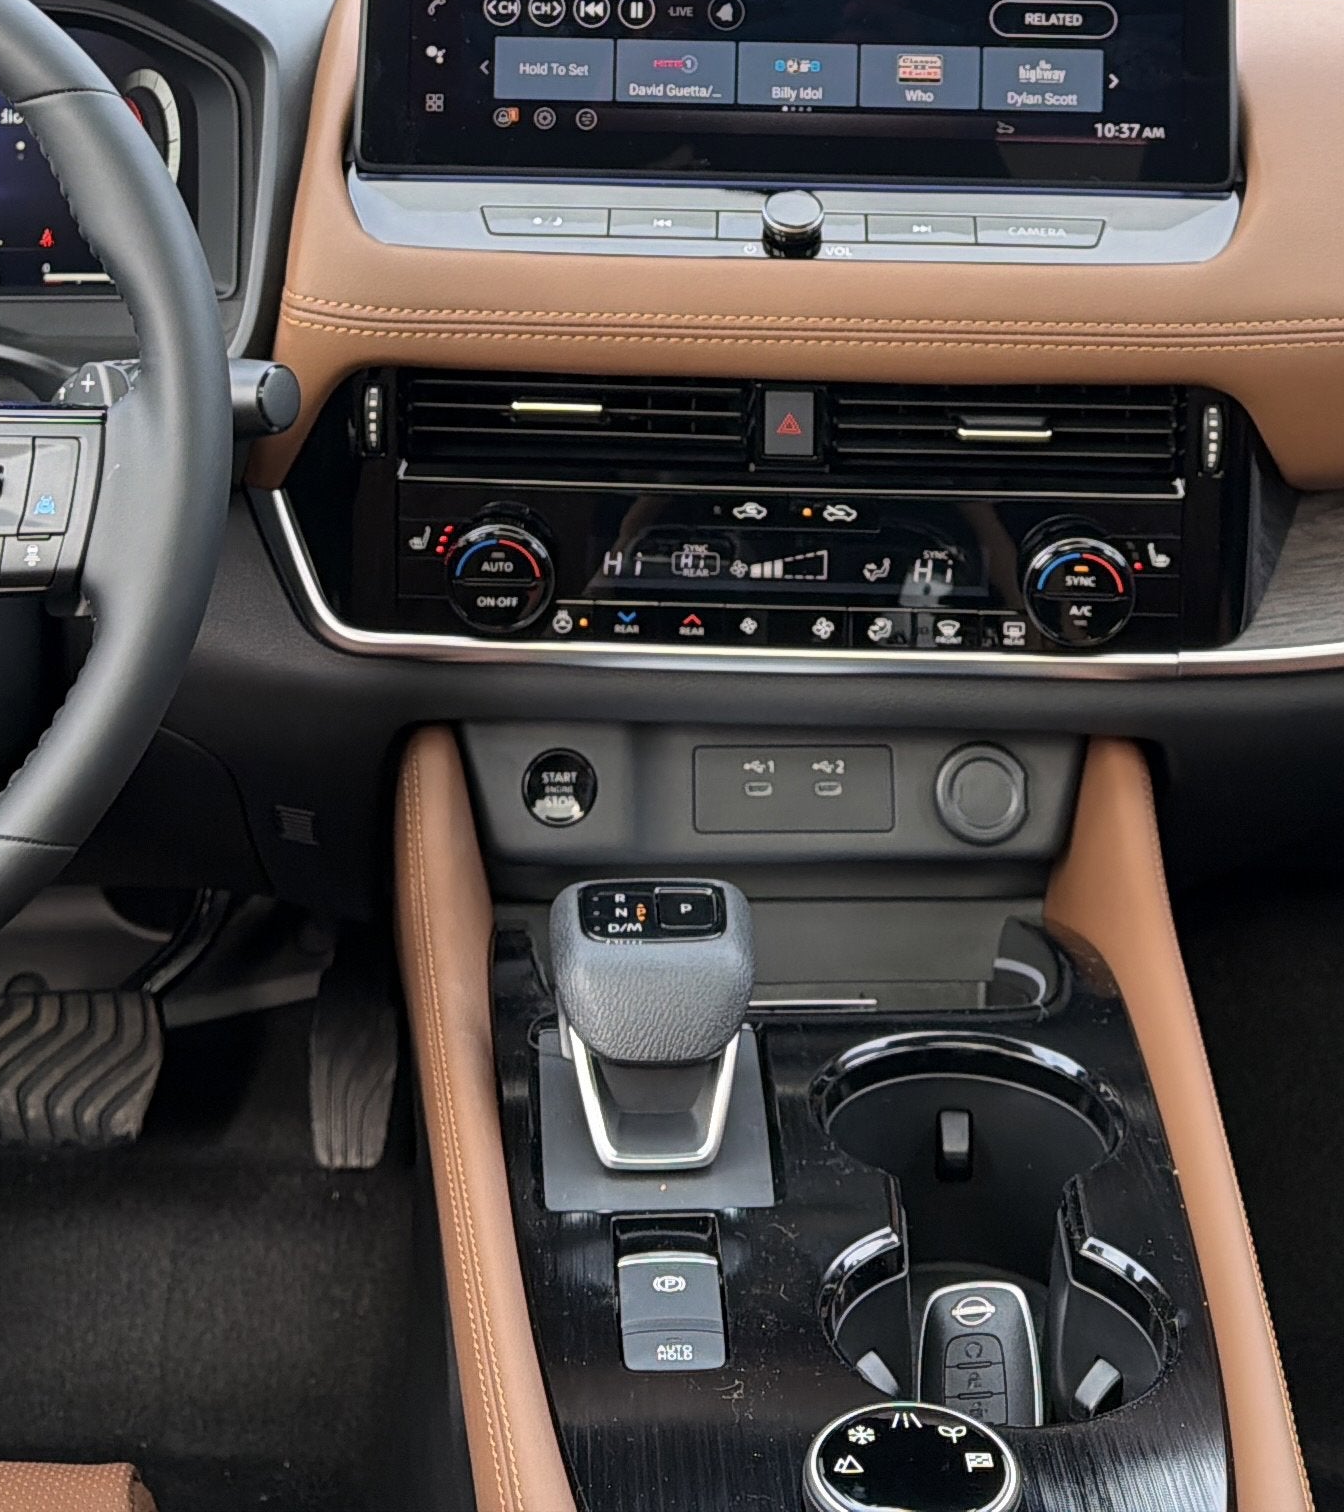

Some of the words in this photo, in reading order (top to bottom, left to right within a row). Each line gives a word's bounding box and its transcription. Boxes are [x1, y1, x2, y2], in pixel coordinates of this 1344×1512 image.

[1025, 12, 1083, 27] RELATED
[519, 62, 548, 76] Hold
[551, 62, 567, 76] To
[568, 63, 589, 77] Set
[629, 83, 663, 97] David
[771, 87, 797, 102] Billy
[799, 87, 823, 100] Idol
[905, 89, 934, 102] Who
[1007, 91, 1042, 107] Dylan
[1044, 92, 1078, 106] Scott
[1094, 122, 1141, 139] 10:37
[1142, 126, 1166, 139] AM
[1007, 224, 1067, 237] CAMERA
[824, 246, 853, 257] VOL
[481, 561, 514, 573] AUTO
[683, 567, 710, 577] REAR
[1066, 575, 1096, 588] SYNC
[1068, 605, 1093, 618] A/C
[614, 624, 640, 633] REAR
[679, 626, 705, 636] REAR
[541, 771, 578, 784] START
[614, 893, 626, 903] R
[614, 907, 628, 918] N
[679, 903, 692, 915] P
[607, 922, 643, 934] D/M
[657, 1344, 693, 1353] AUTO
[658, 1353, 693, 1361] HOLD
